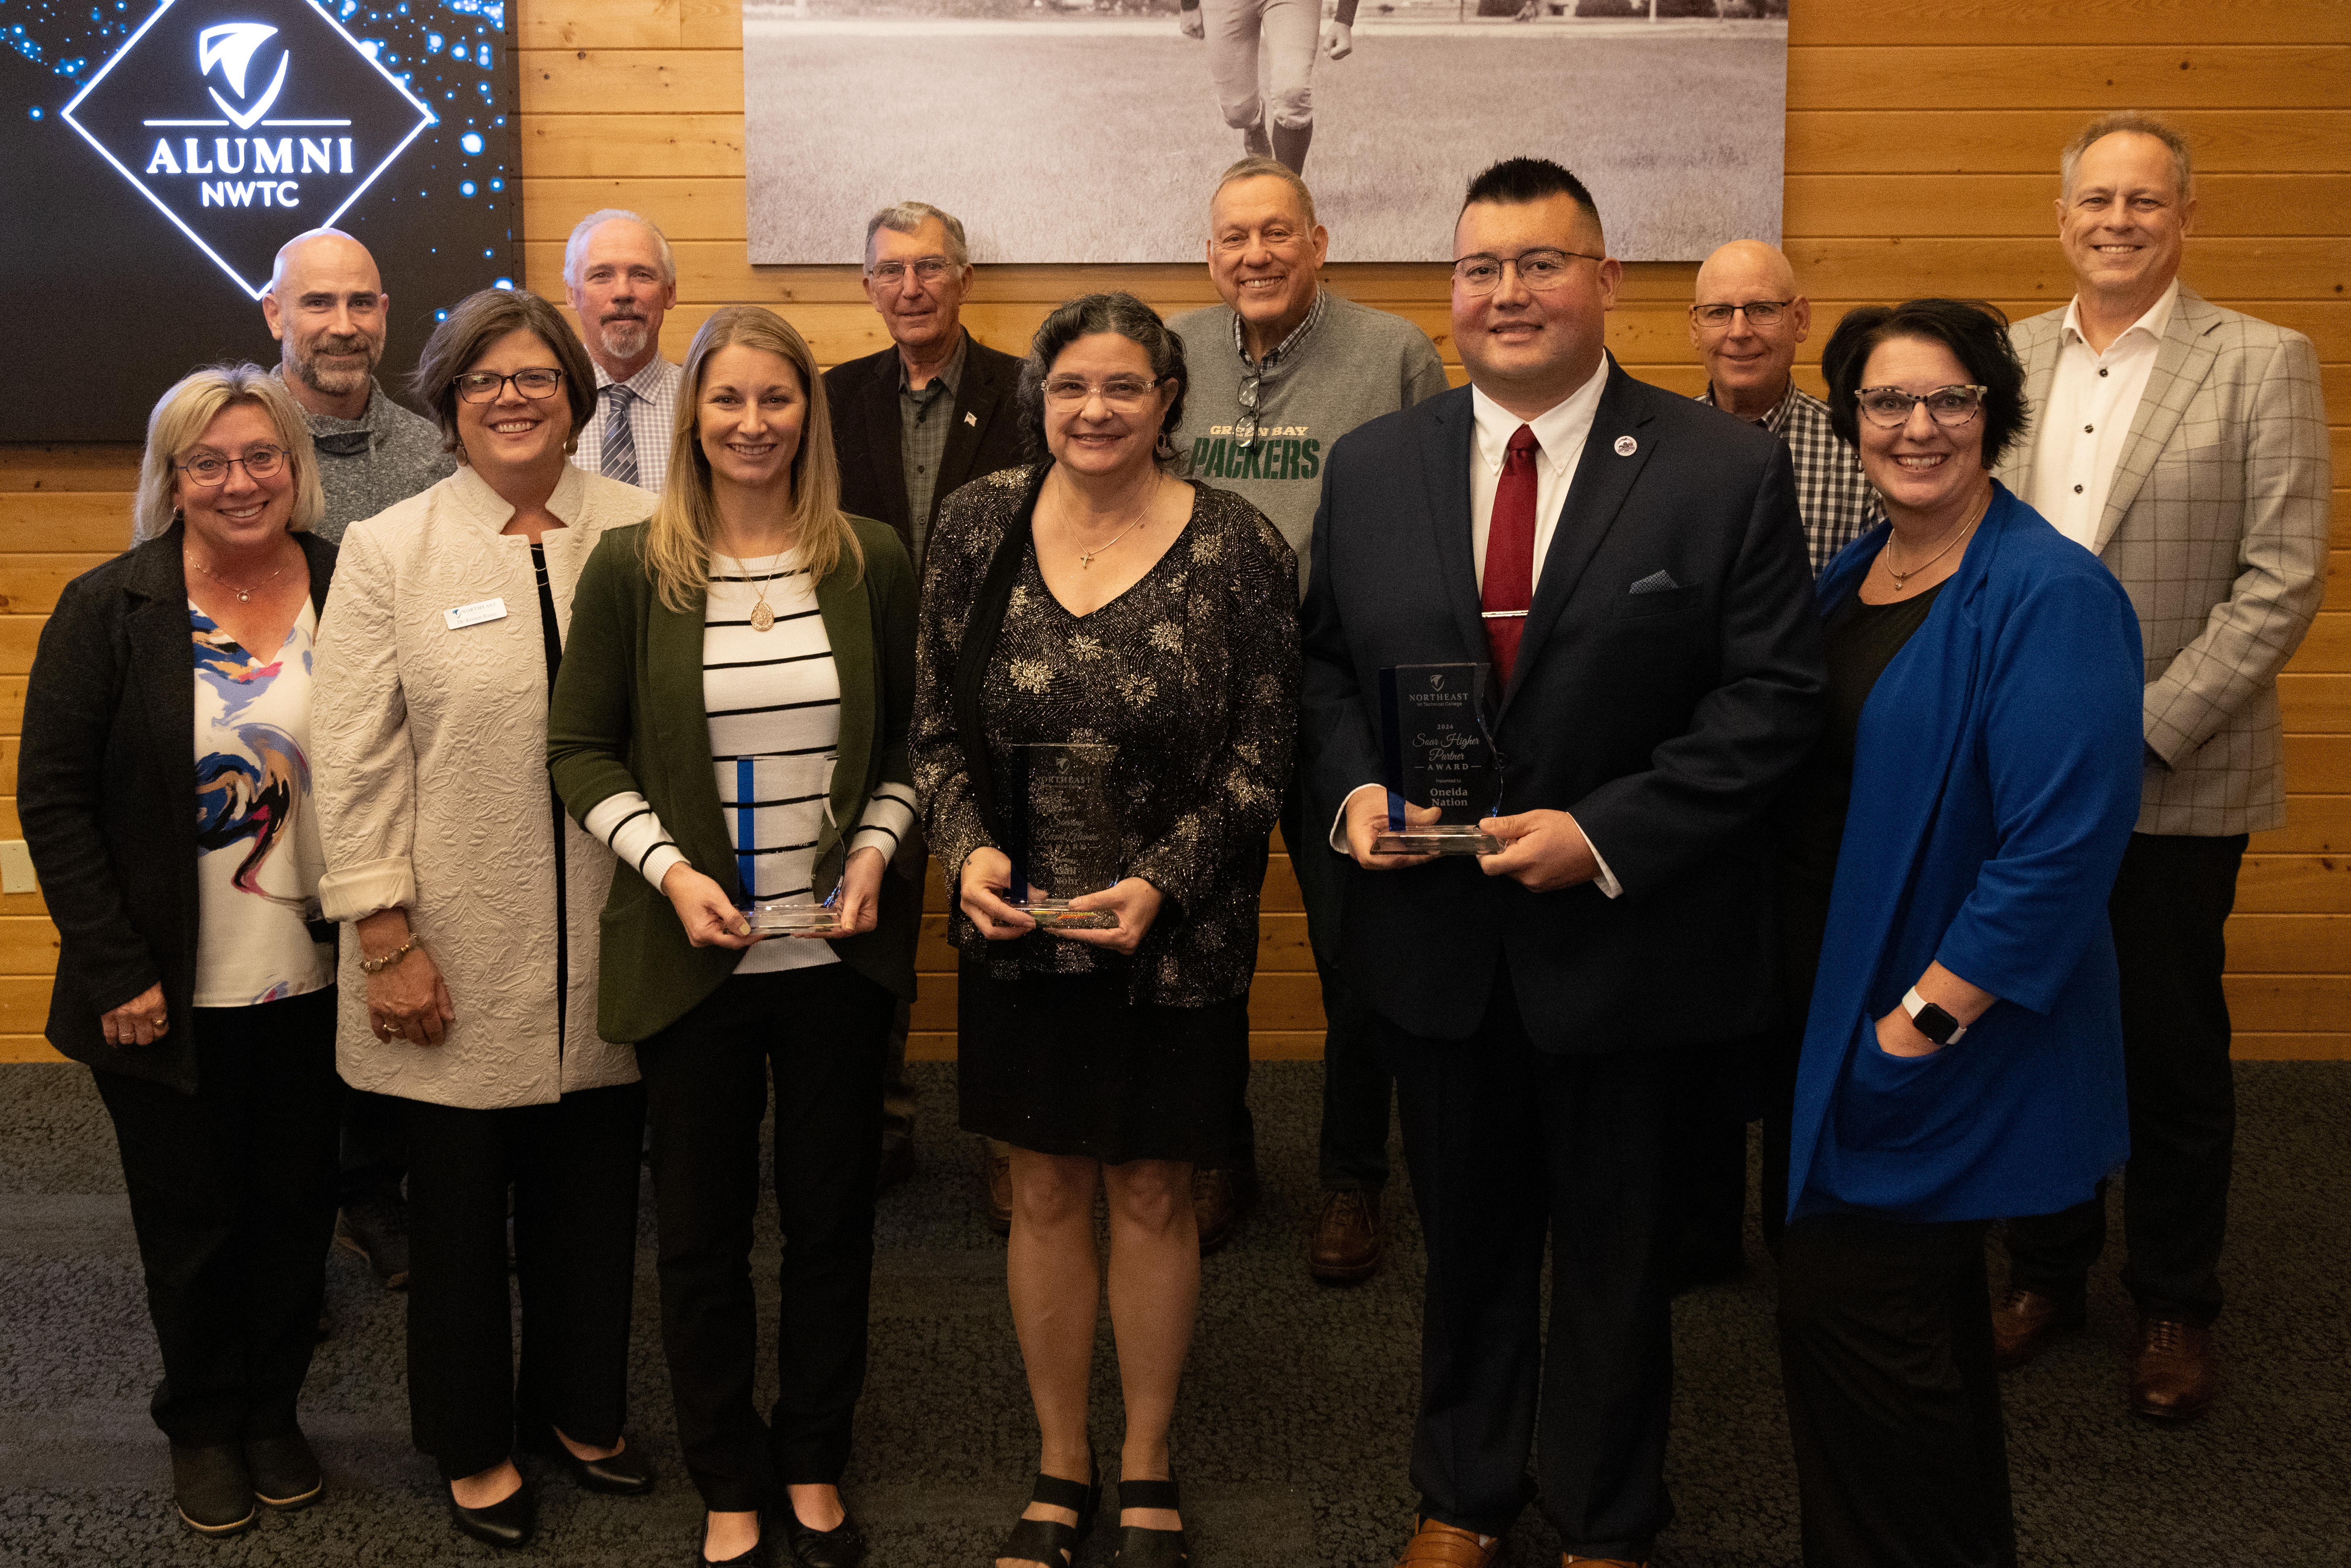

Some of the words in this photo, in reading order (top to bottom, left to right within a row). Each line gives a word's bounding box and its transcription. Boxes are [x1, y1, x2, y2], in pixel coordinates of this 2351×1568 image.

[147, 138, 354, 174] ALUMNI
[202, 181, 300, 207] NWTC
[1210, 425, 1269, 437] GREEN
[1271, 426, 1309, 436] BAY
[1189, 437, 1320, 480] PACKERS
[462, 603, 496, 613] NORTHEAST
[1413, 733, 1439, 747] Soar
[1440, 733, 1480, 749] Higher
[1429, 748, 1465, 761] Partner
[1430, 787, 1468, 796] Oneida
[1431, 798, 1468, 806] Nation
[1049, 814, 1084, 830] Soaring
[1036, 828, 1067, 840] Recent
